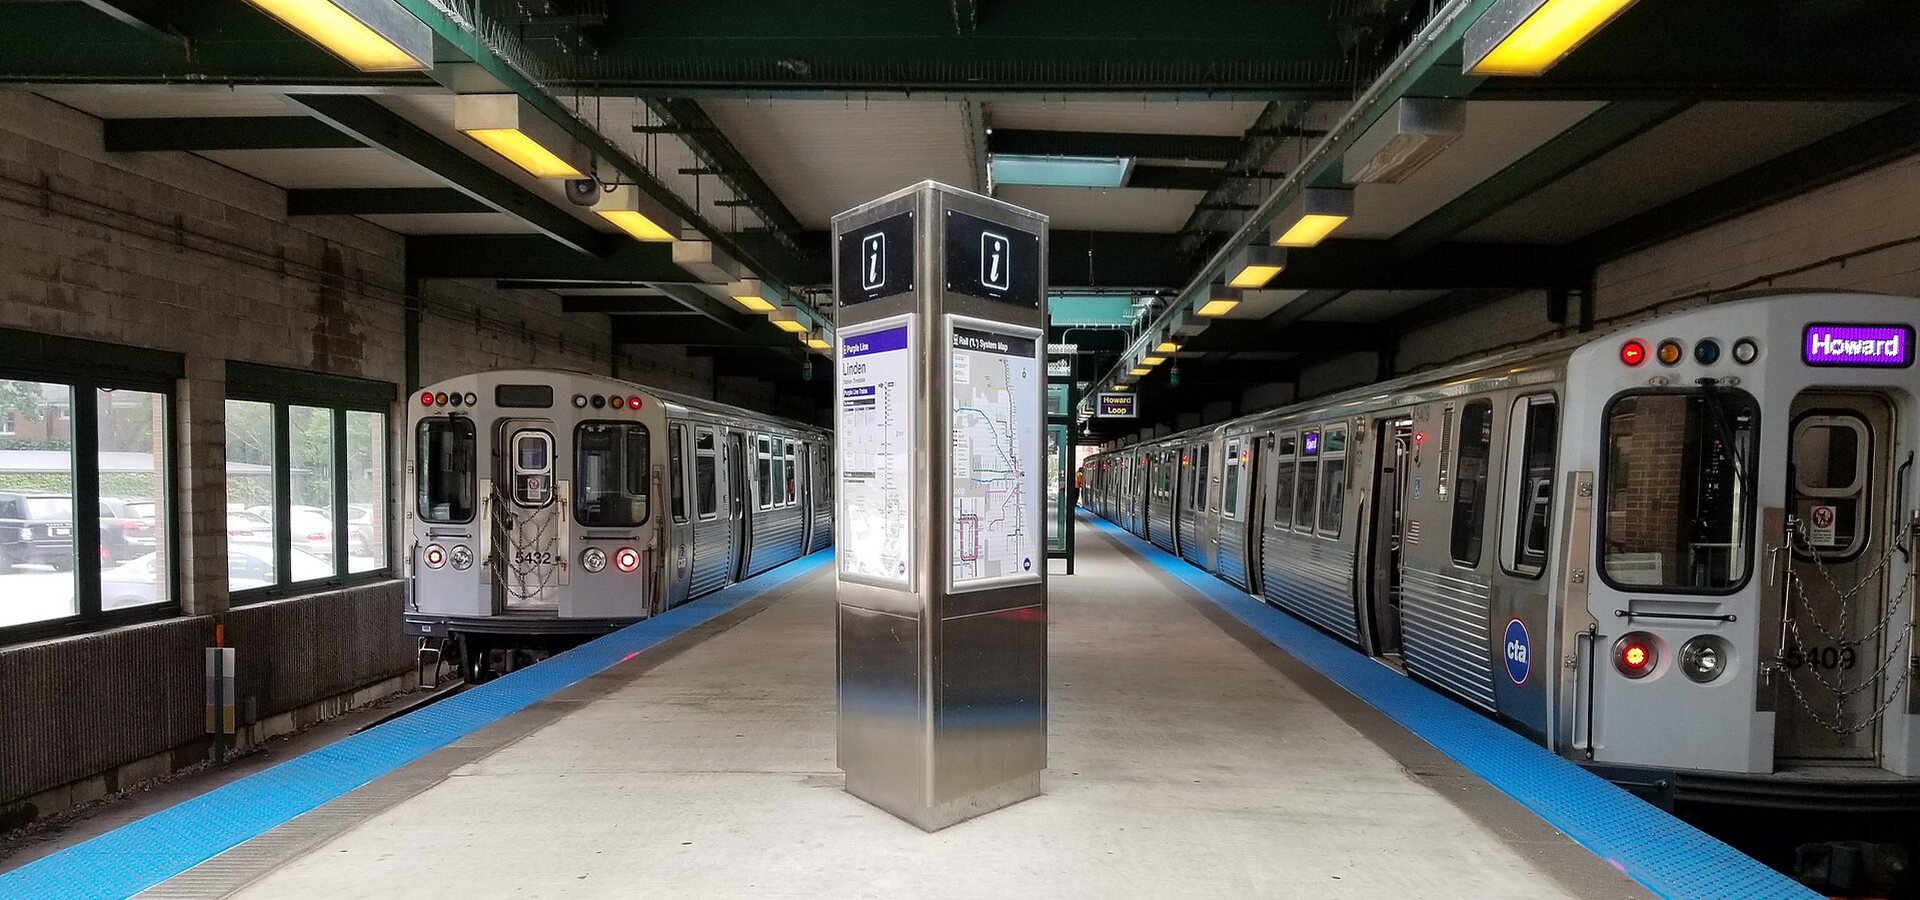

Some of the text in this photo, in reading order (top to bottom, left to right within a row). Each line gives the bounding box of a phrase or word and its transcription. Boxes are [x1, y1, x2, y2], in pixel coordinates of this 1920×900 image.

[847, 342, 869, 354] Purple Line
[959, 335, 968, 346] Rail
[980, 339, 997, 350] System
[998, 341, 1008, 352] Map
[1812, 333, 1899, 356] Howard
[843, 361, 866, 376] Linden
[1108, 407, 1126, 415] Loop
[515, 551, 551, 565] 5432
[1786, 646, 1856, 670] 5409
